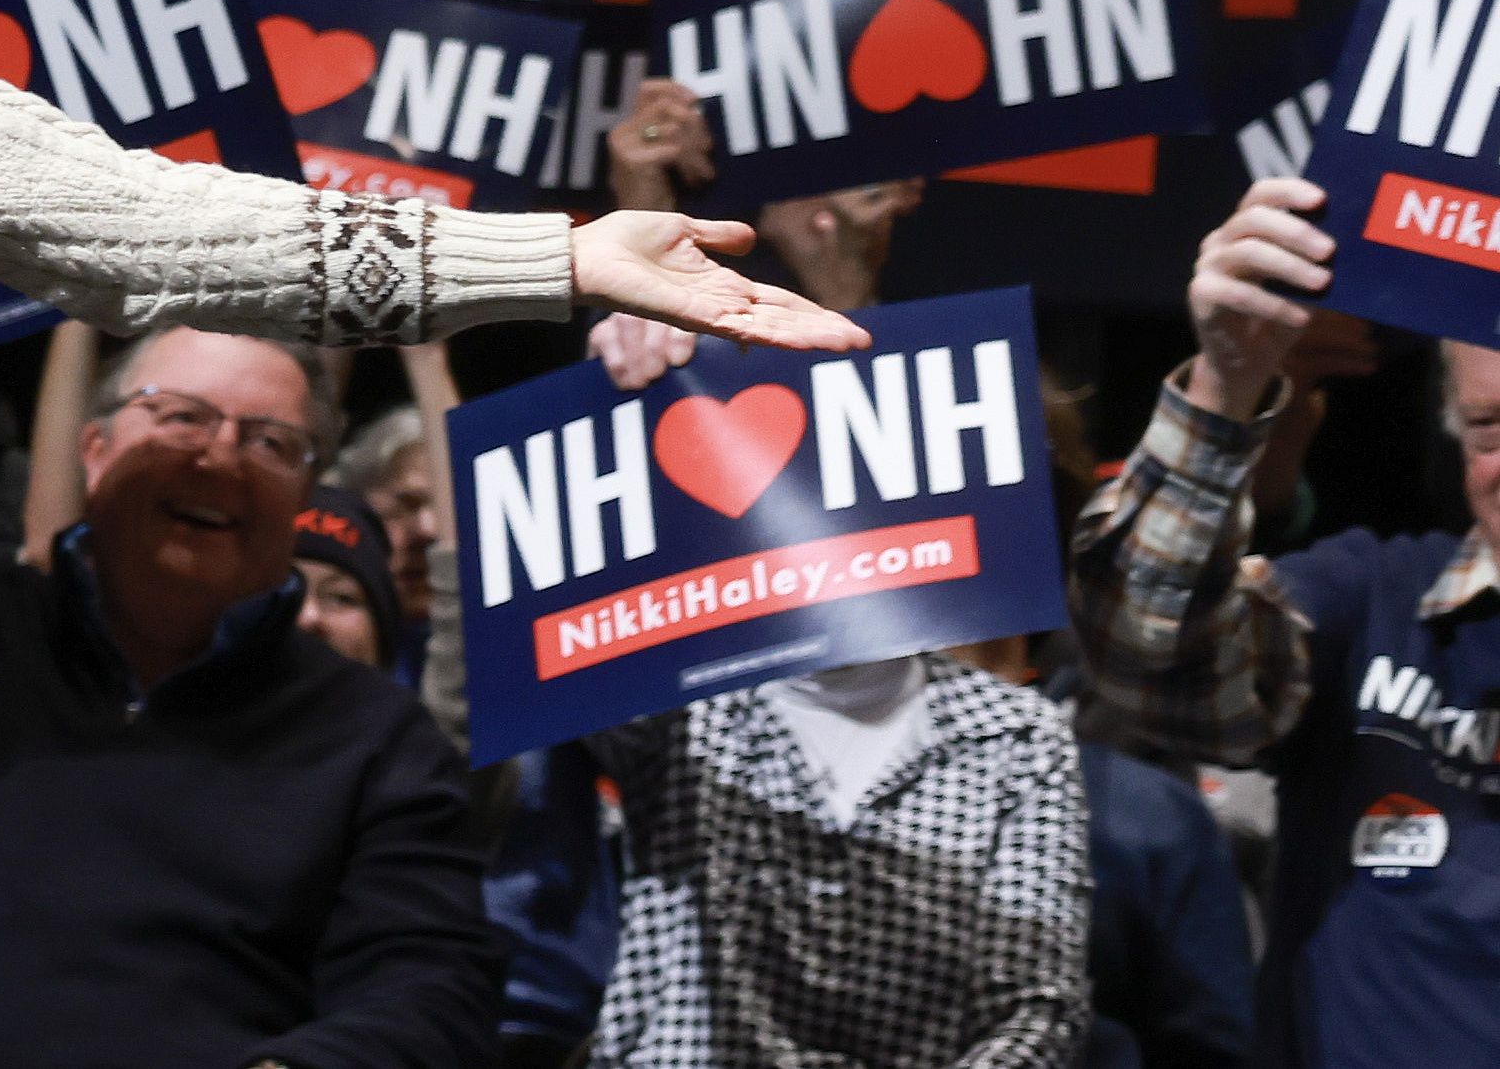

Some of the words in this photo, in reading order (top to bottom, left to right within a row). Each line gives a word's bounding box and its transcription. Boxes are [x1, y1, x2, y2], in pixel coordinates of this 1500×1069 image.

[363, 28, 554, 177] NH
[473, 397, 657, 609] NH
[810, 338, 1025, 512] NH
[558, 535, 953, 658] NikkiHaley.com
